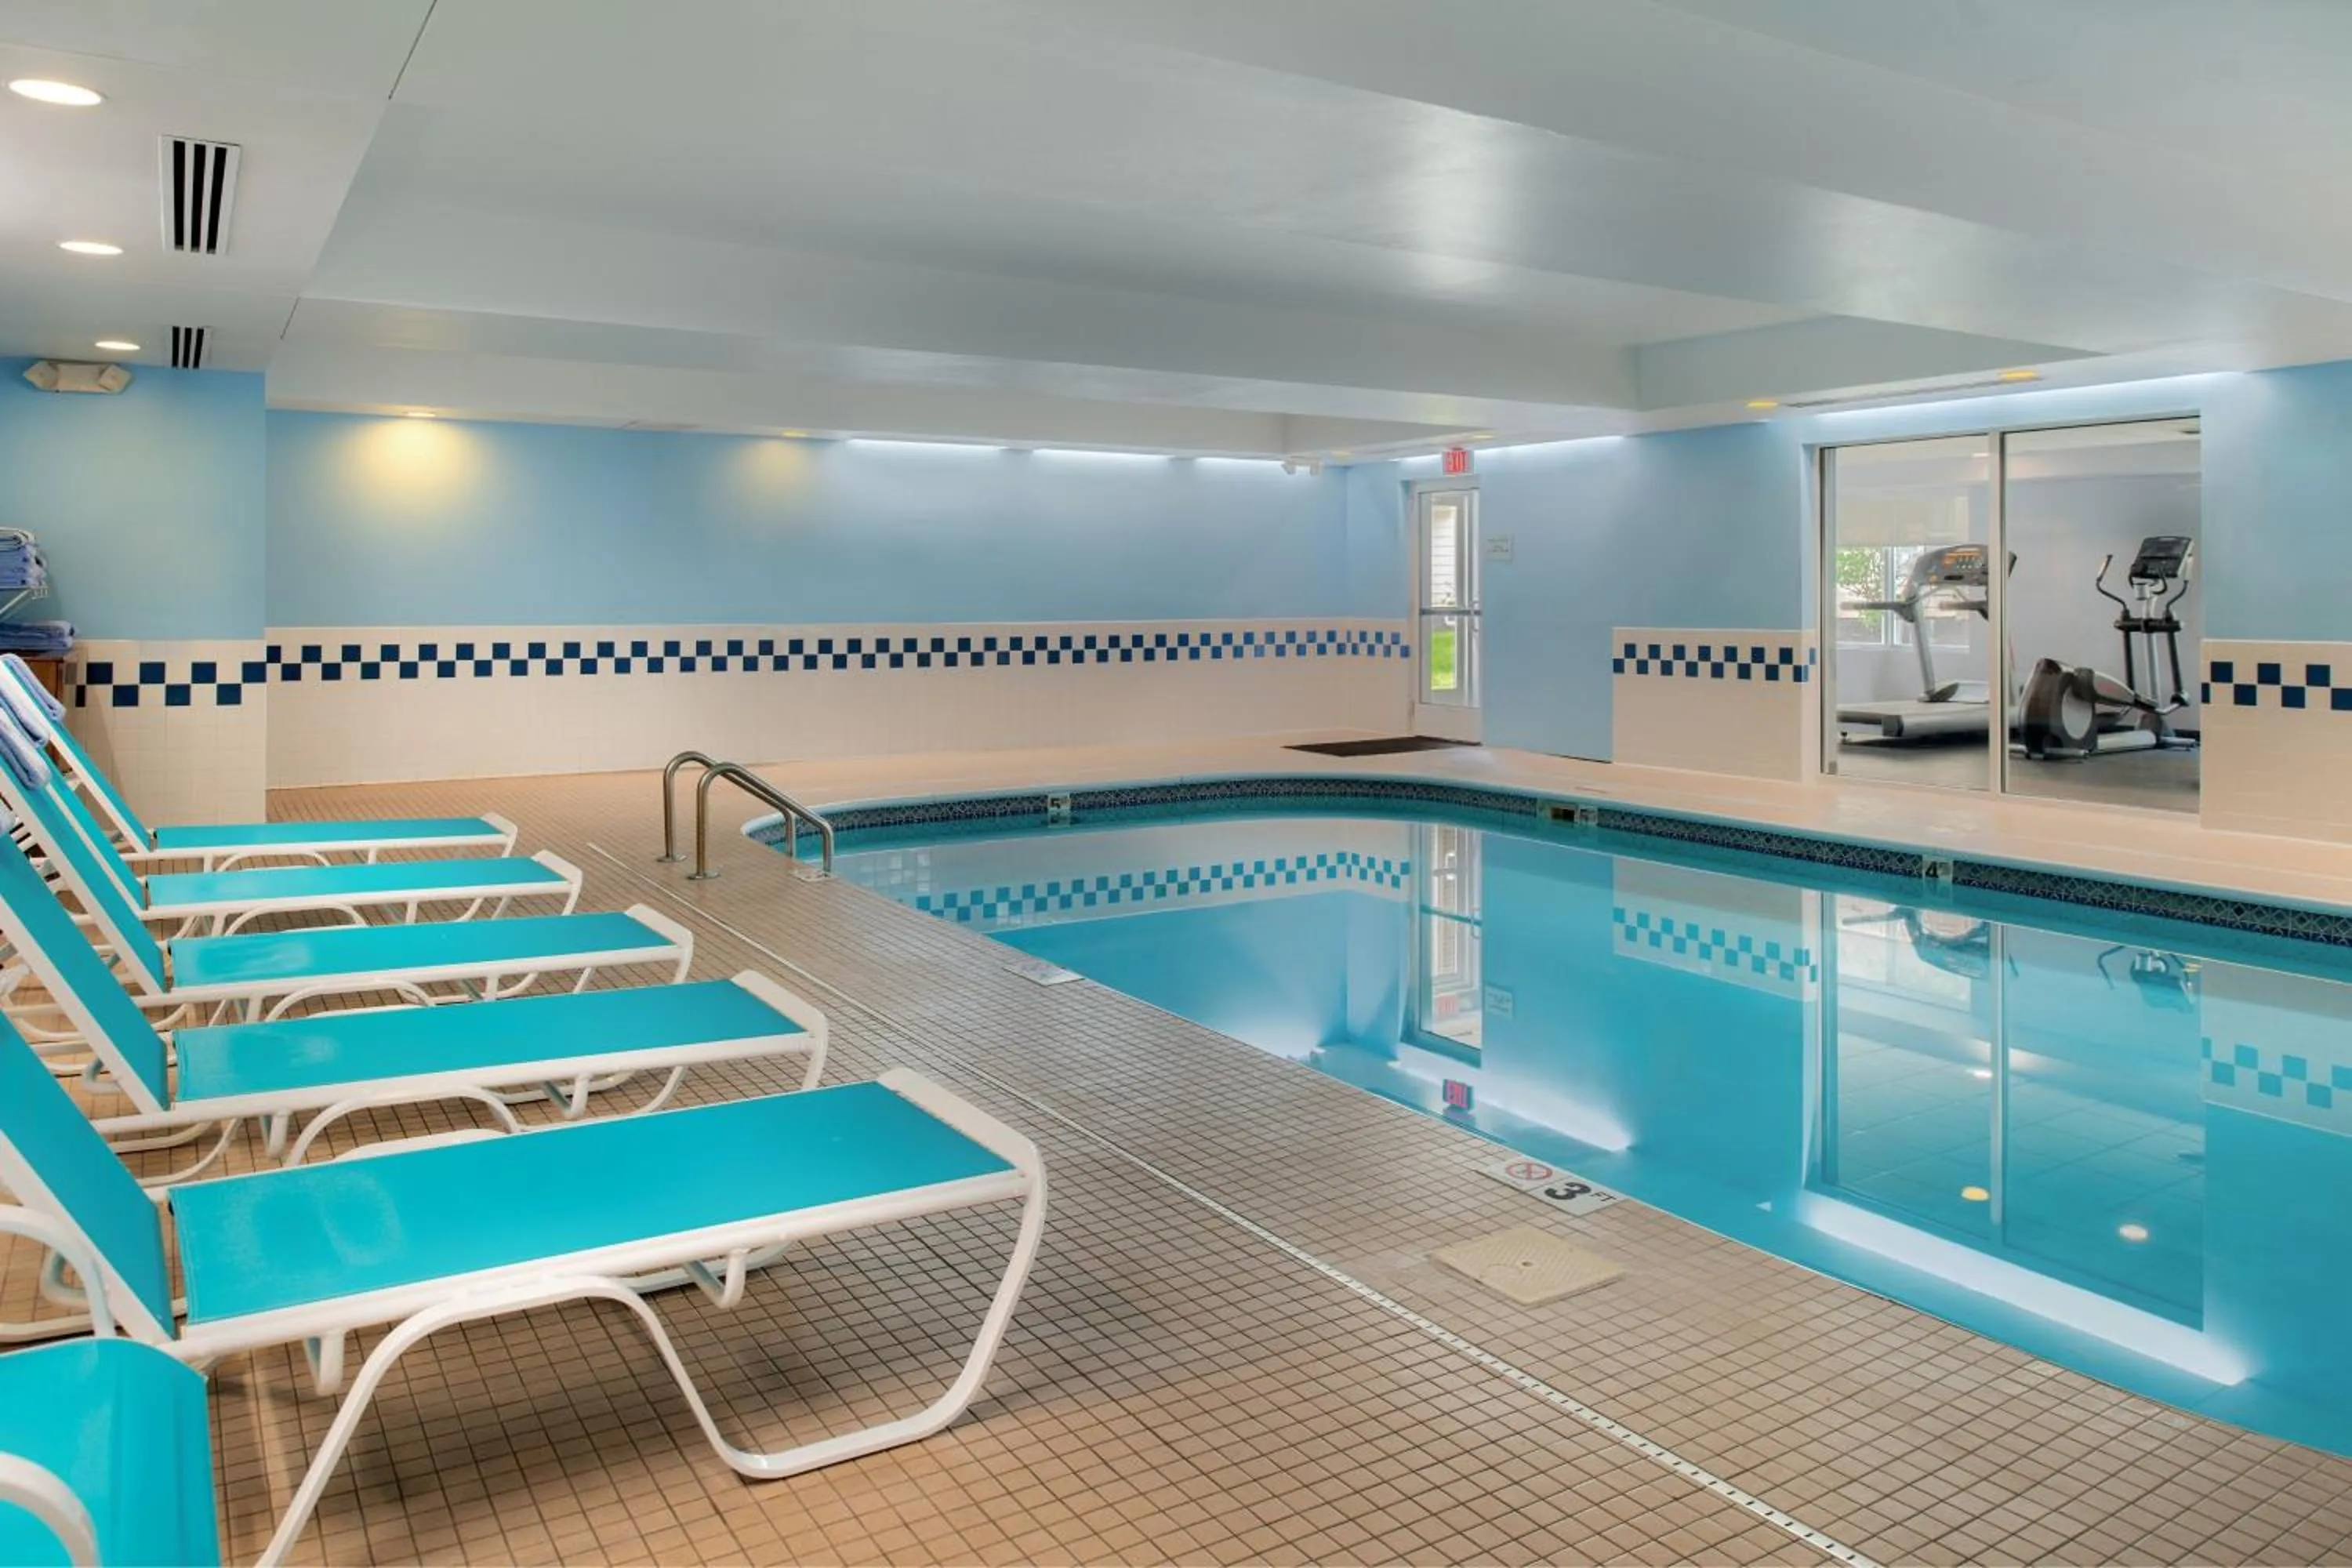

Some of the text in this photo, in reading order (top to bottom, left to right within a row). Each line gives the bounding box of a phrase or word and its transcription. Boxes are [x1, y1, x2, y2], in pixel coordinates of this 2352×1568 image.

[1926, 861, 1939, 878] 4
[1544, 1181, 1617, 1203] 3 FT
